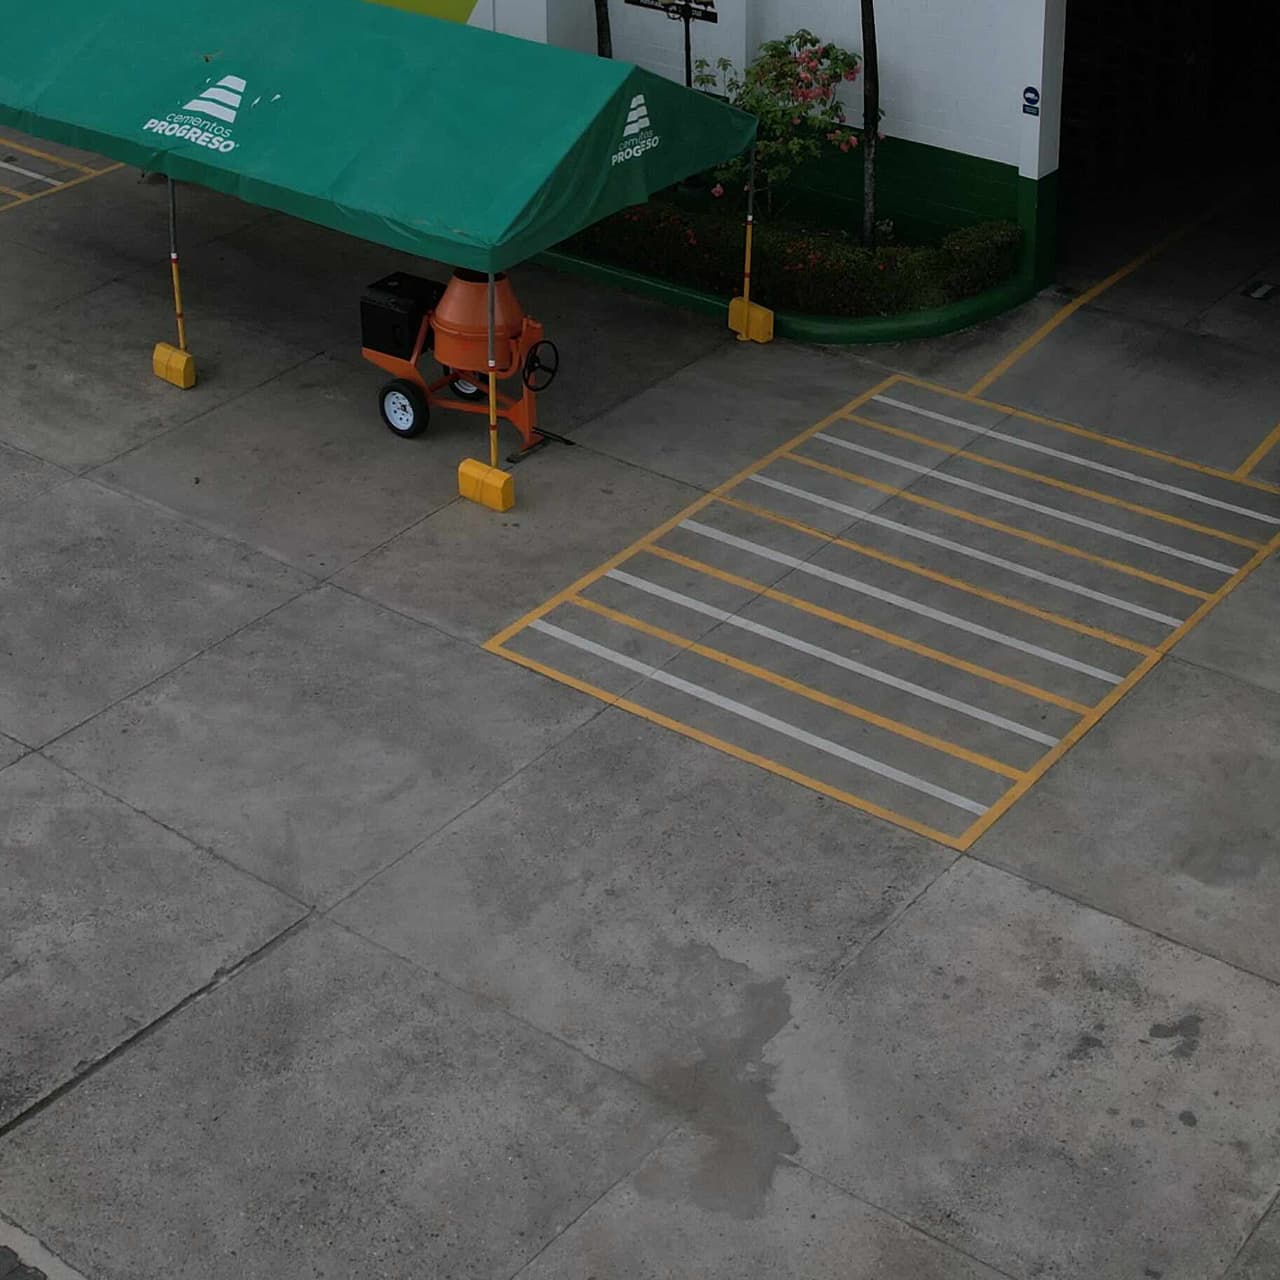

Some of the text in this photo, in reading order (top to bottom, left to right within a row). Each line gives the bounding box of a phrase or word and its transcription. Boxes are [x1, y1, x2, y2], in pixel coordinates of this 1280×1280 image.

[143, 119, 235, 152] PROGRESO
[166, 113, 232, 138] cementos
[611, 136, 660, 166] PROGESO
